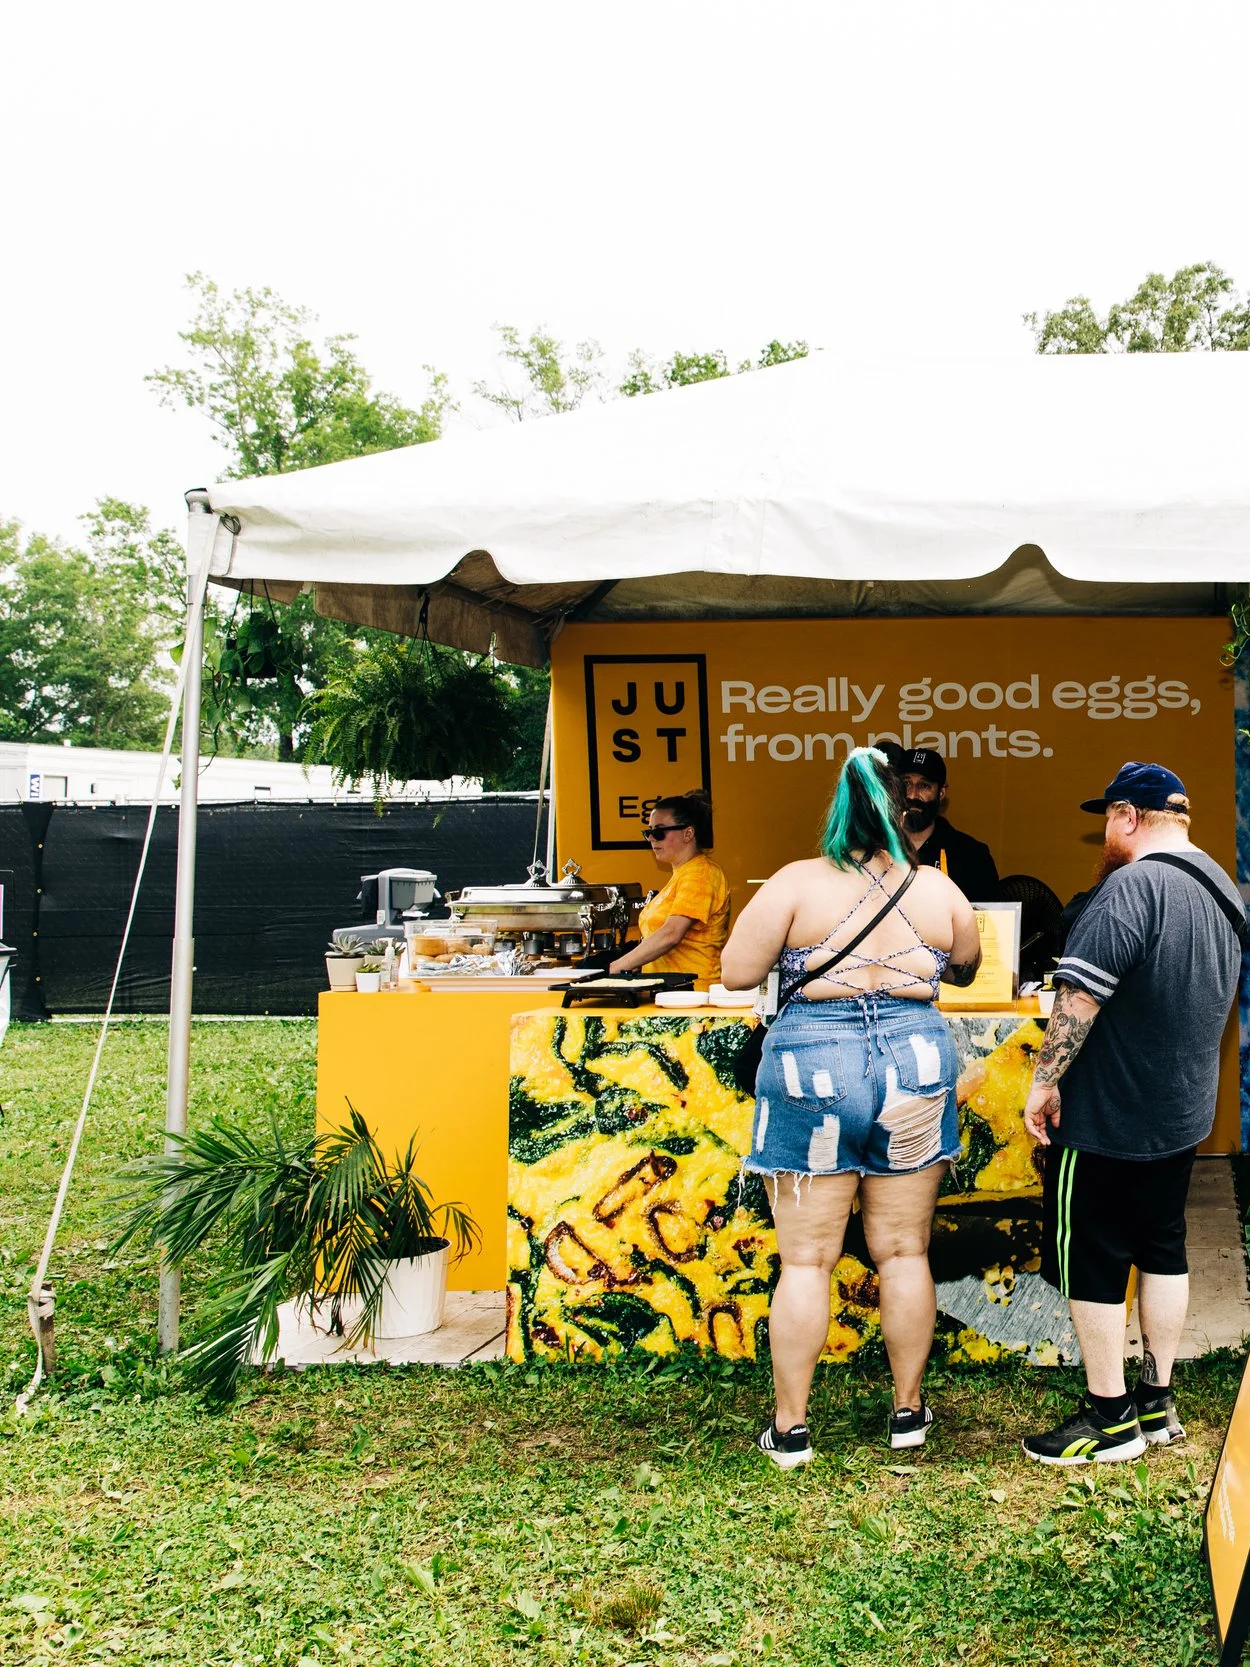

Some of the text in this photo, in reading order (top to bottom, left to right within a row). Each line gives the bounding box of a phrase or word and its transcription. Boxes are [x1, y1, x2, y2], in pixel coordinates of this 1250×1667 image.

[721, 674, 1201, 723] Really good eggs,
[720, 723, 855, 762] from
